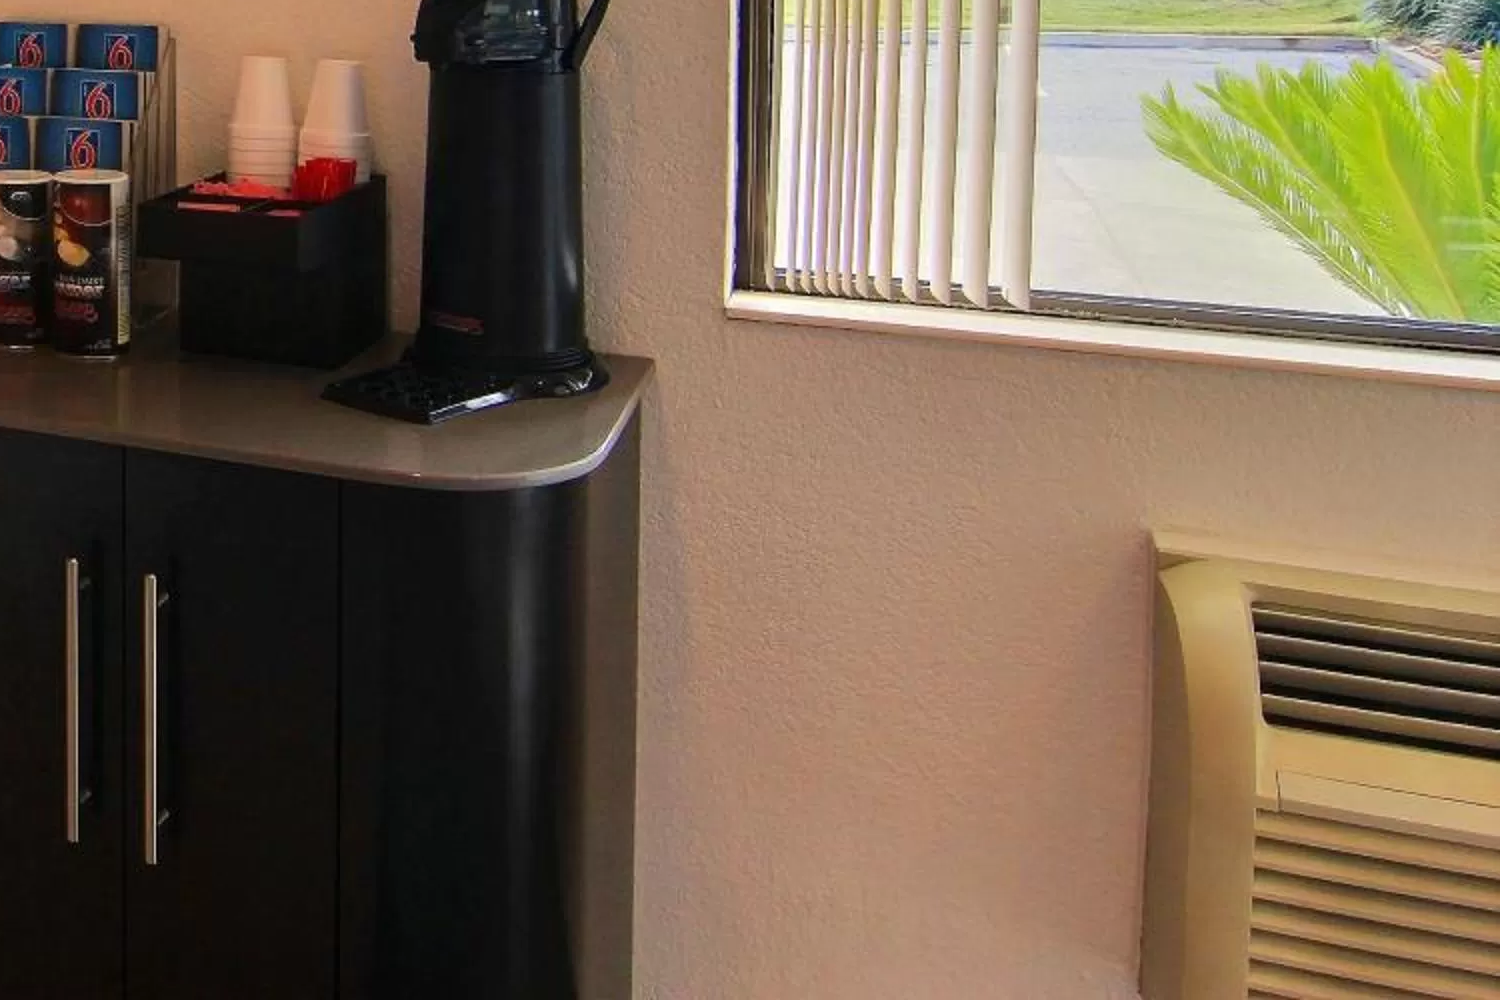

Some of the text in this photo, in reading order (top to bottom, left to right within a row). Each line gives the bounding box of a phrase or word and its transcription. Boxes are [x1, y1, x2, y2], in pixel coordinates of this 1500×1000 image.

[19, 32, 42, 68] 6
[108, 35, 132, 70] 6
[86, 81, 111, 119] 6
[71, 130, 96, 168] 6
